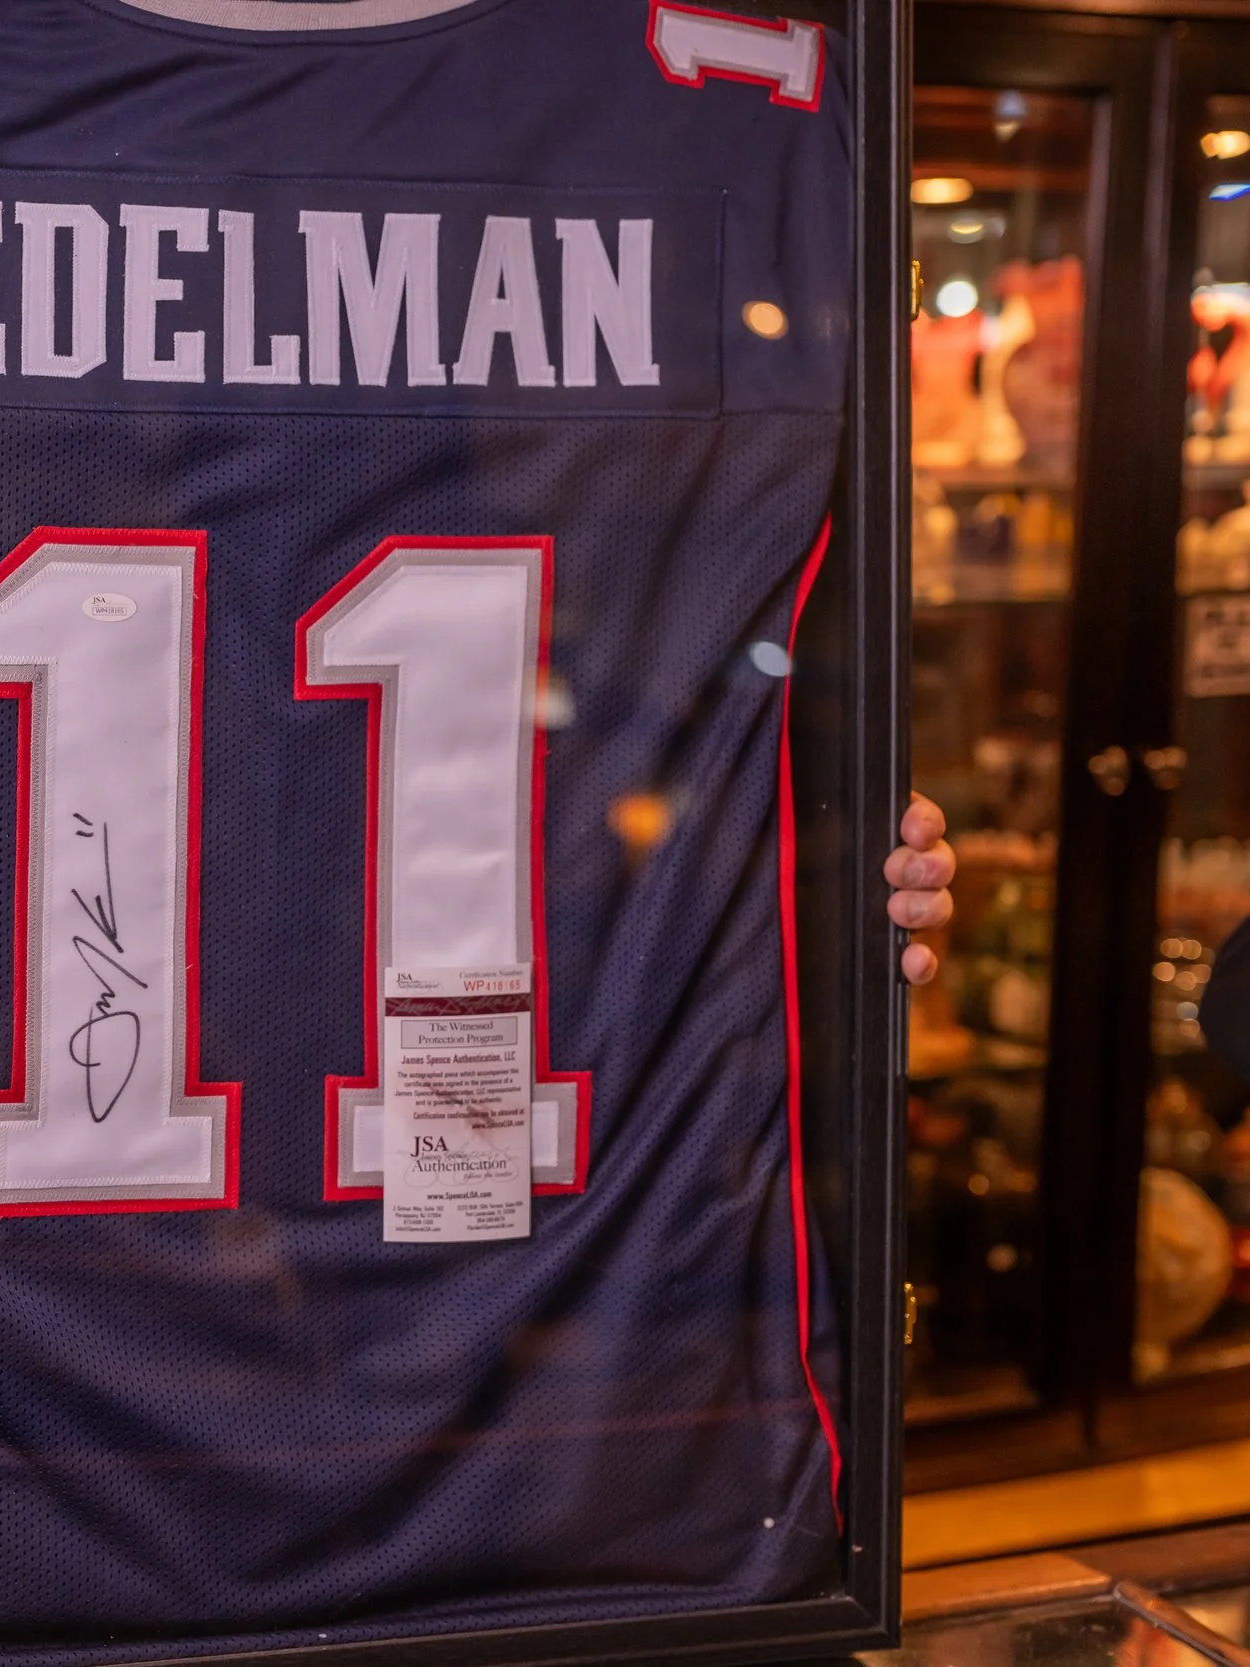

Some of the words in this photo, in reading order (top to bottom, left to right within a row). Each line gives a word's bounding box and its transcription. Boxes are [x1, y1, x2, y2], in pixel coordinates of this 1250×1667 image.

[92, 596, 106, 604] JSA
[396, 972, 413, 983] JSA
[429, 1022, 447, 1032] The
[449, 1020, 494, 1031] Witnessed
[418, 1034, 464, 1044] Protection
[466, 1033, 504, 1045] Program
[401, 1055, 424, 1065] James
[426, 1054, 451, 1067] Spence
[504, 1051, 516, 1061] LLC
[410, 1136, 449, 1157] JSA
[412, 1157, 507, 1172] Authentication
